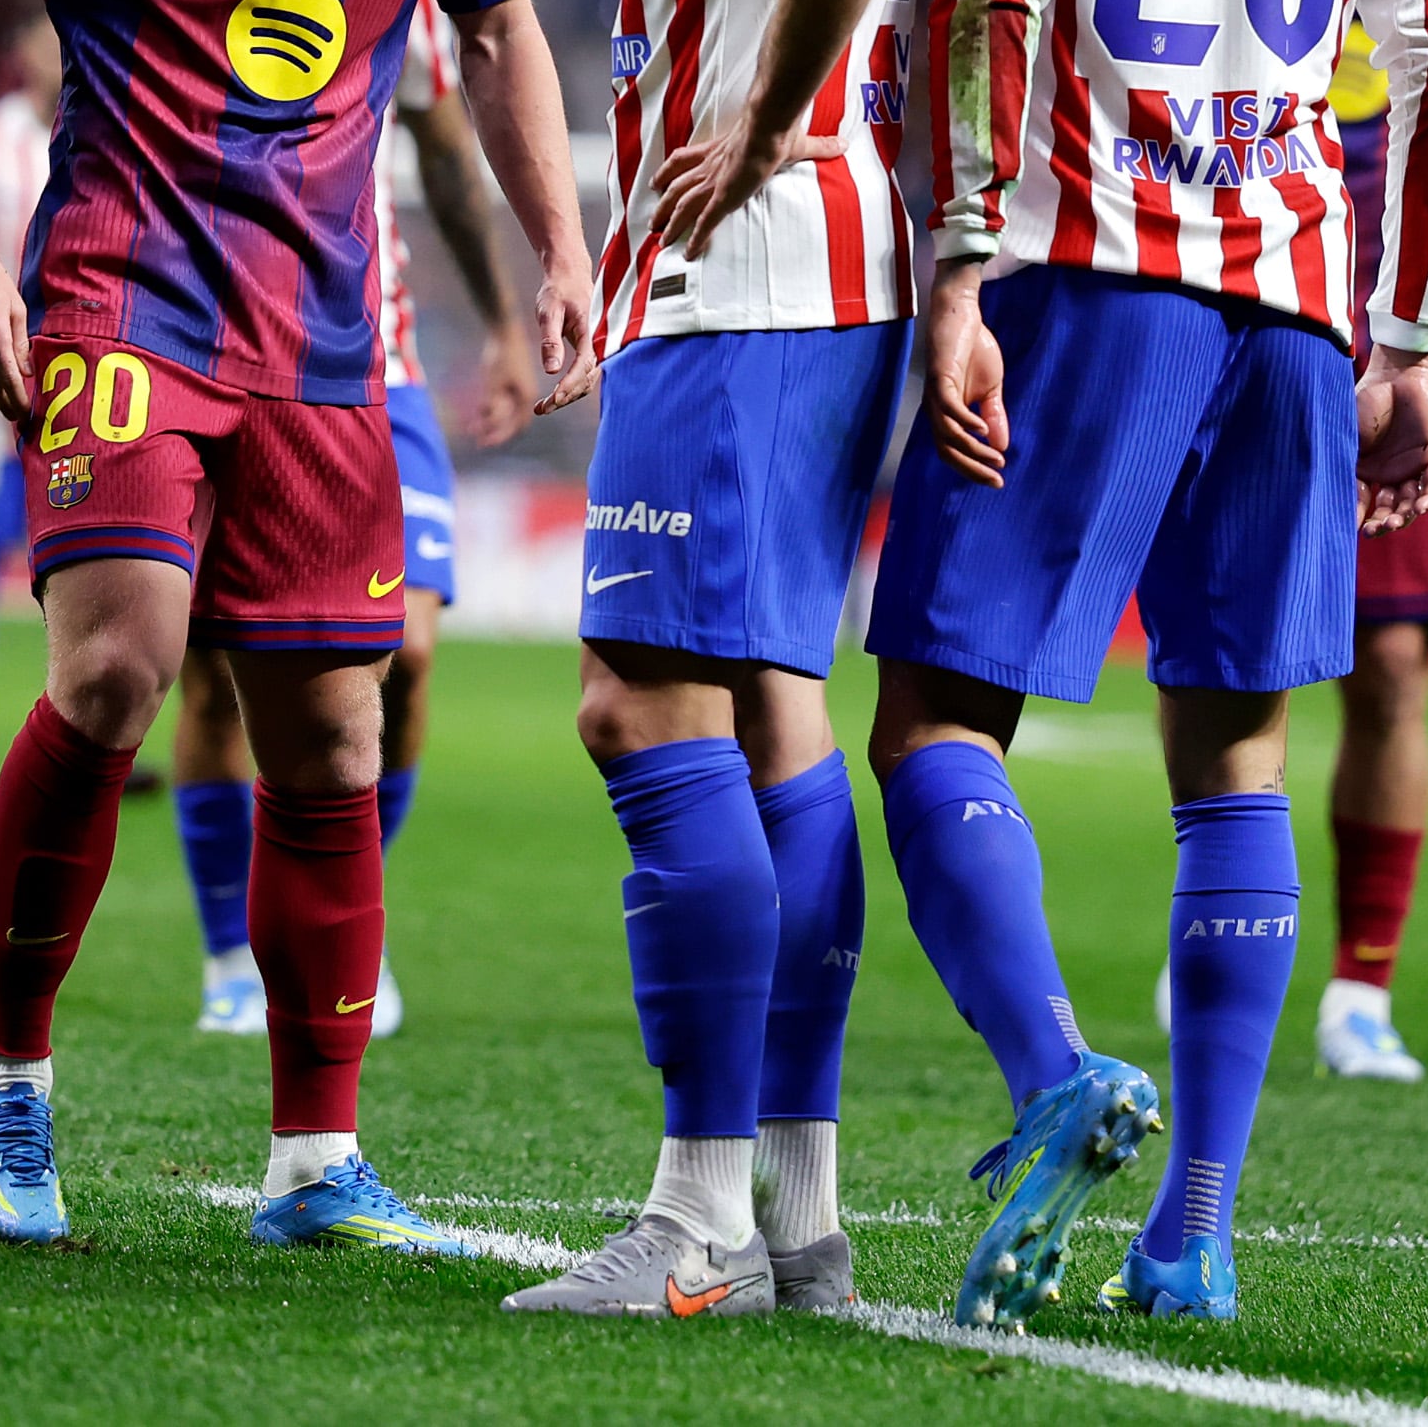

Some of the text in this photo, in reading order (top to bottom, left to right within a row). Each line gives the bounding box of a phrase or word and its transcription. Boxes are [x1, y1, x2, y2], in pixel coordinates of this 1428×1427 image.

[1164, 95, 1289, 139] VIST
[39, 351, 152, 454] 20
[585, 498, 693, 538] omAve
[1183, 914, 1294, 940] ATLETI
